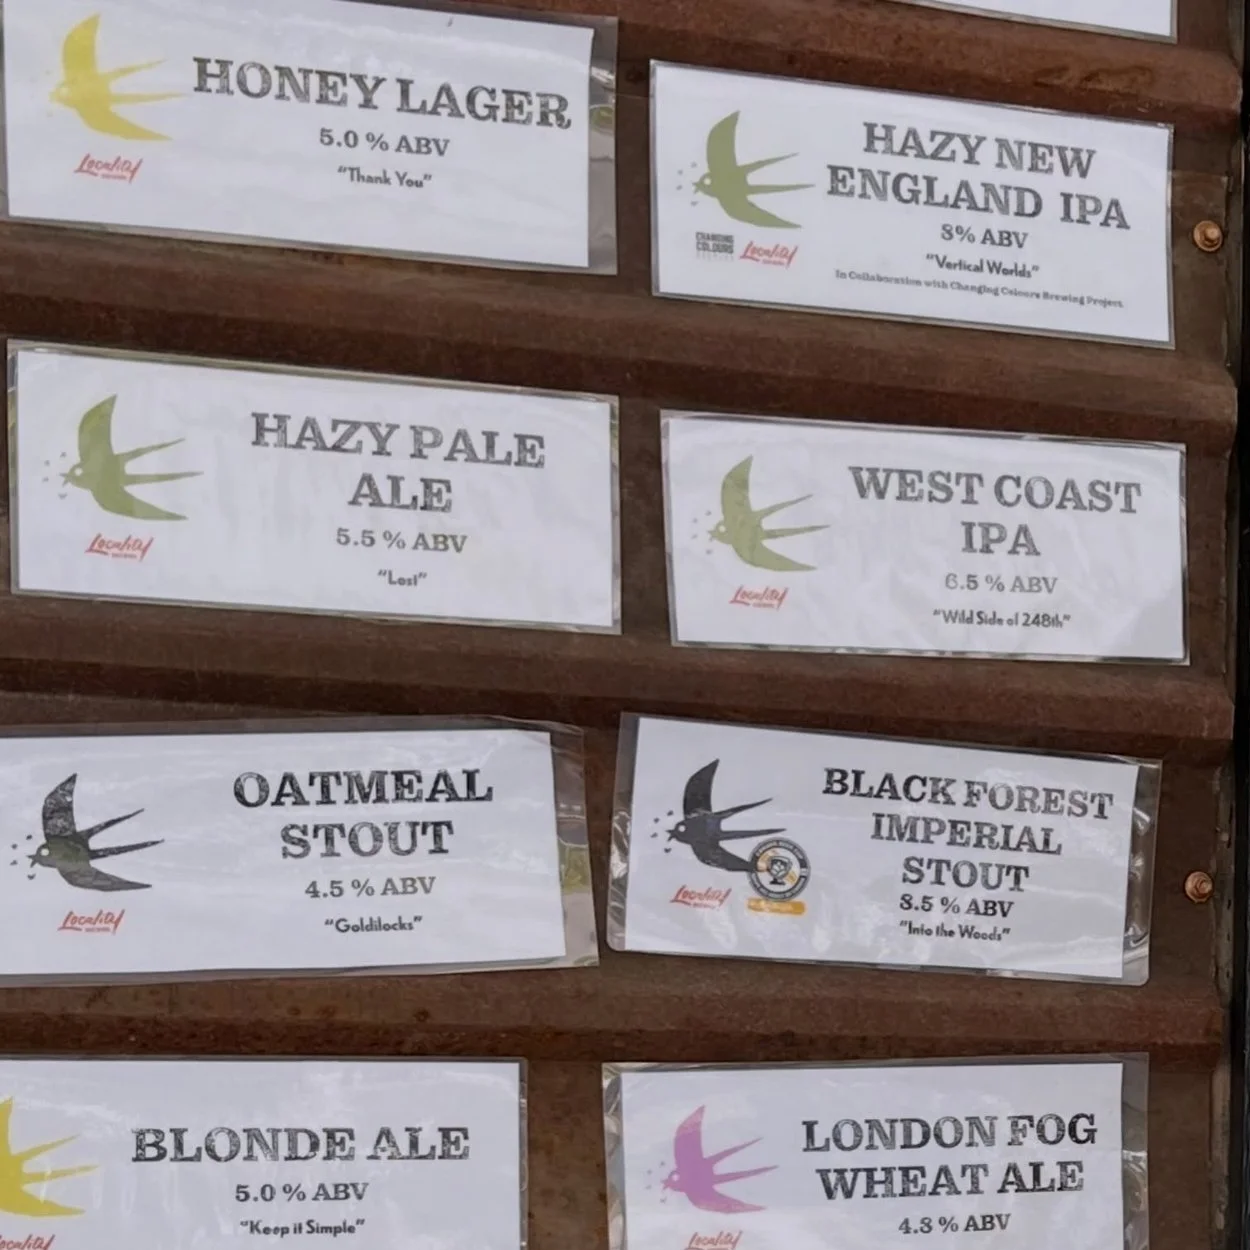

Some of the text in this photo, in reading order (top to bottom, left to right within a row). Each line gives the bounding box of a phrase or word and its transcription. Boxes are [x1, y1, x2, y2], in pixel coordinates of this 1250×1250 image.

[192, 55, 572, 130] HONEY LAGER
[319, 126, 451, 157] 5.0 % ABV
[862, 121, 1097, 179] HAZY NEW
[826, 164, 1132, 231] ENGLAND IPA
[940, 223, 1029, 250] 8% ABV
[250, 411, 546, 469] HAZY PALE
[347, 472, 453, 514] ALE
[847, 465, 1142, 515] WEST COAST
[335, 526, 468, 554] 5.5 % ABV
[960, 520, 1042, 557] IPA
[944, 572, 1059, 595] 6.5 % ABV
[975, 609, 1004, 626] Side
[233, 768, 494, 809] OATMEAL
[821, 767, 1115, 821] BLACK FOREST
[280, 819, 455, 860] STOUT
[870, 811, 1063, 856] IMPERIAL
[304, 875, 437, 899] 4.5 % ABV
[901, 855, 1030, 893] STOUT
[899, 893, 1015, 919] 8.5 % ABV
[935, 921, 956, 938] the
[131, 1126, 470, 1163] BLONDE ALE
[801, 1112, 1099, 1153] LONDON FOG
[234, 1182, 370, 1203] 5.0 % ABV
[814, 1160, 1085, 1201] WHEAT ALE
[937, 1215, 960, 1234] %
[963, 1212, 1012, 1233] ABV
